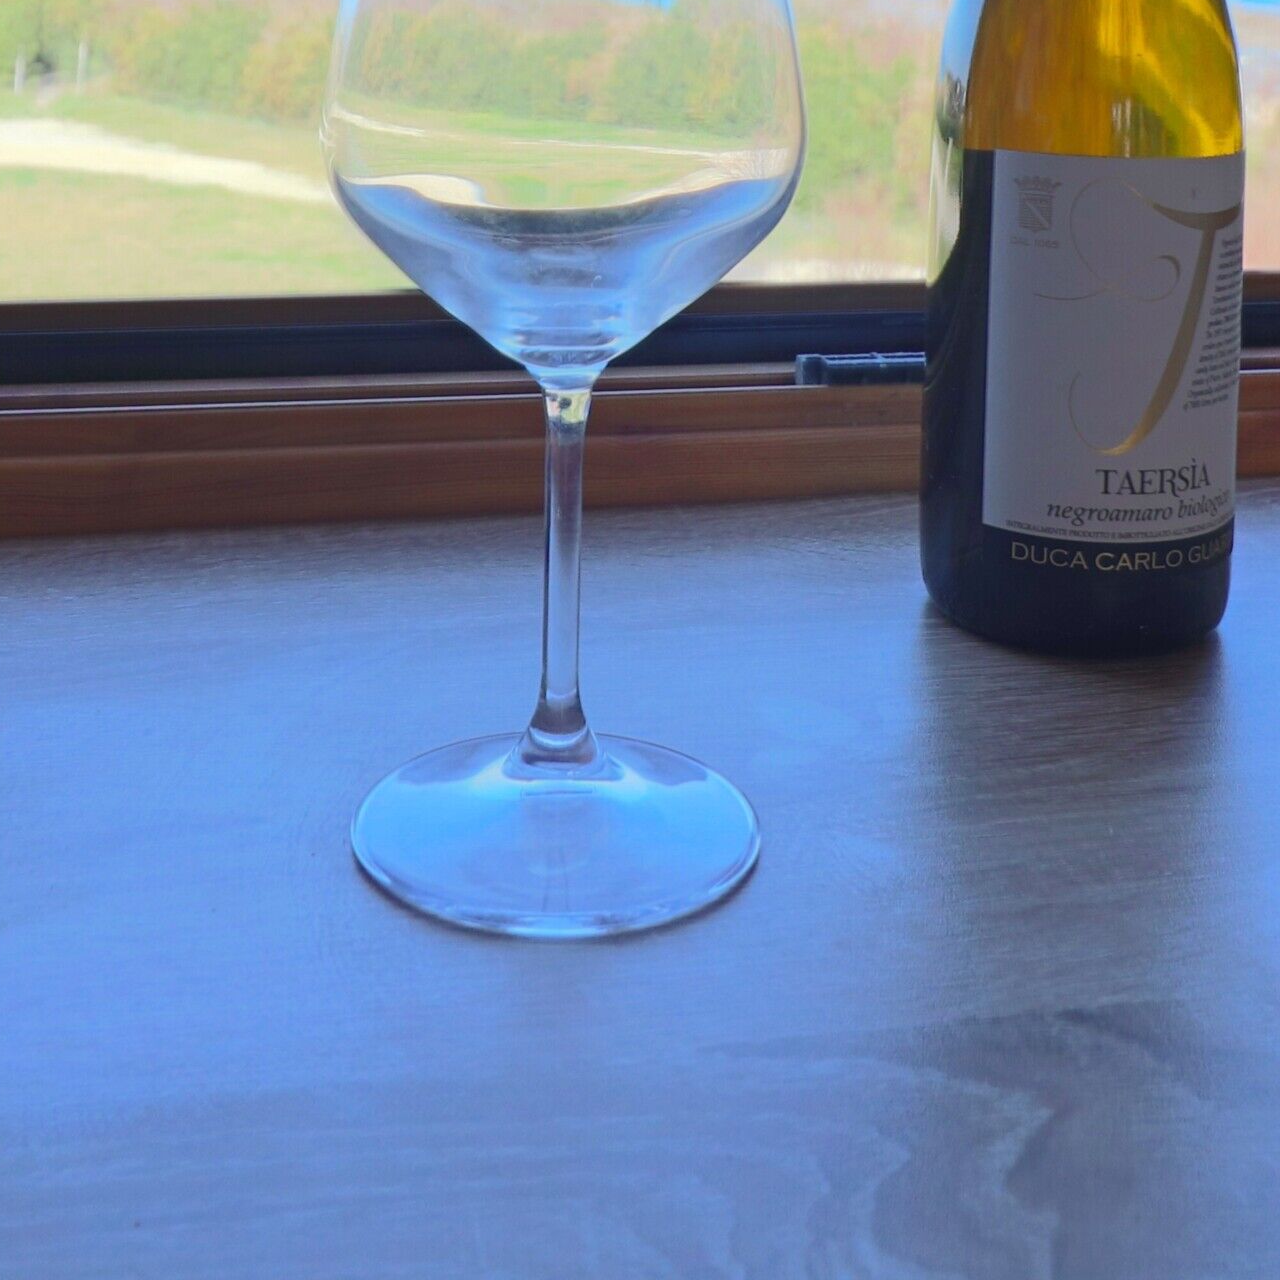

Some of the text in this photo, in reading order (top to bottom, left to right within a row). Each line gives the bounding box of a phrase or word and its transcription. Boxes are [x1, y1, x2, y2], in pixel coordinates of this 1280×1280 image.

[1095, 459, 1212, 498] TAERSÌA
[1046, 502, 1173, 527] negroamaro
[1010, 541, 1089, 571] DUCA
[1095, 549, 1184, 572] CARLO
